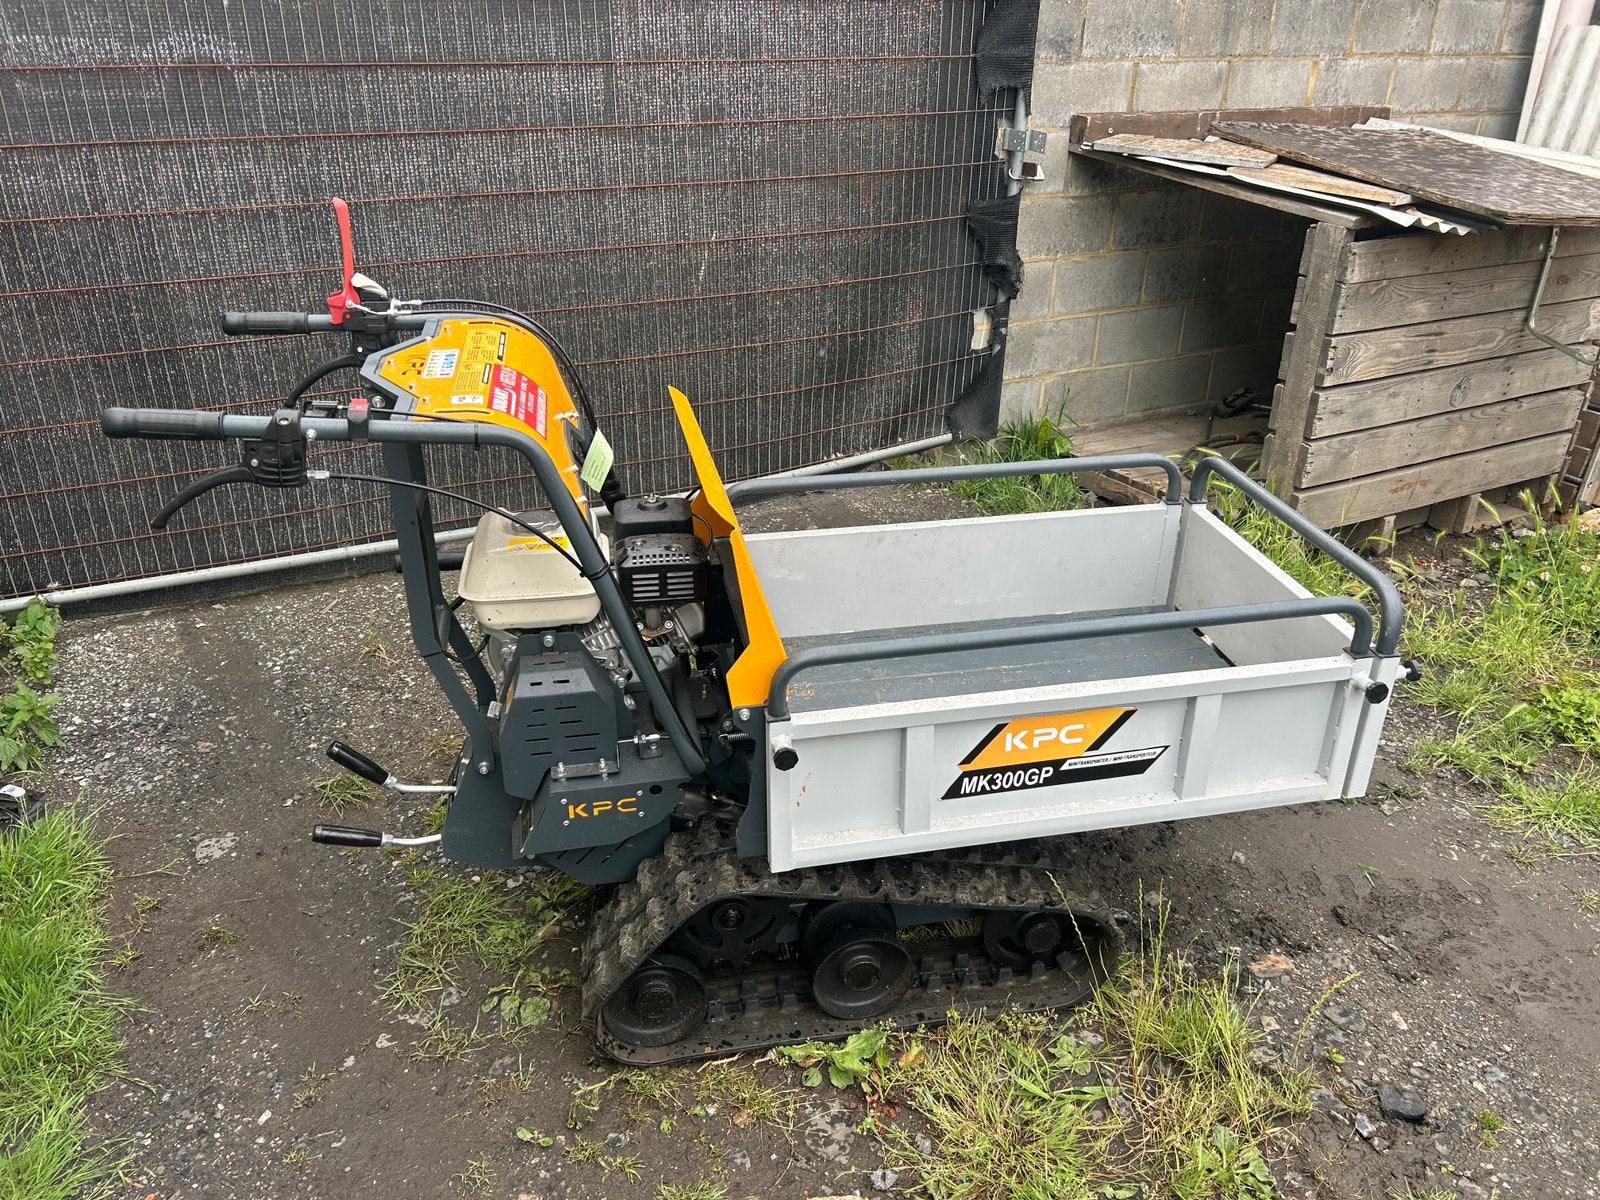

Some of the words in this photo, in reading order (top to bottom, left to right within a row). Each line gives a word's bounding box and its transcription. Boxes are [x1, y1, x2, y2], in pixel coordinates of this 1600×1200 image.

[1004, 722, 1085, 752] KPC
[1068, 758, 1109, 767] MINITRANSPORTER
[960, 766, 1054, 795] MK300GP
[568, 797, 637, 819] KPC
